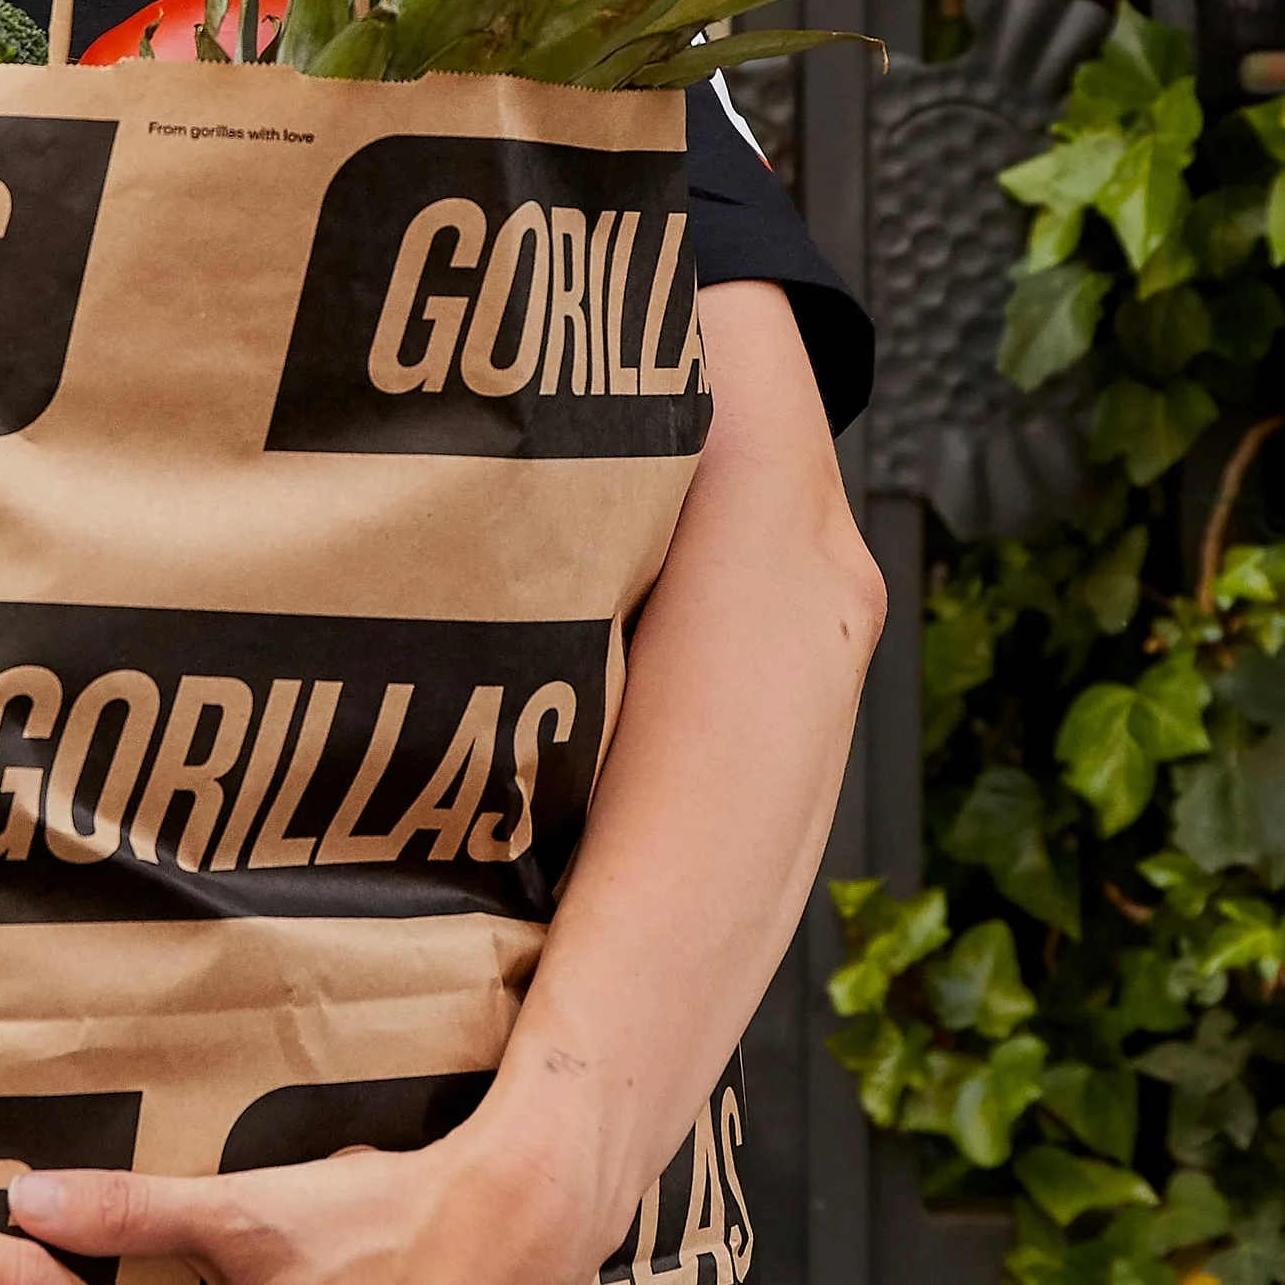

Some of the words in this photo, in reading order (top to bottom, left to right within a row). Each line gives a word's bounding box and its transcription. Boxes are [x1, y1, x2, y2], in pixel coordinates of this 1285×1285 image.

[147, 121, 188, 136] From
[190, 124, 245, 141] gorillas
[247, 125, 281, 142] with
[282, 127, 316, 144] love
